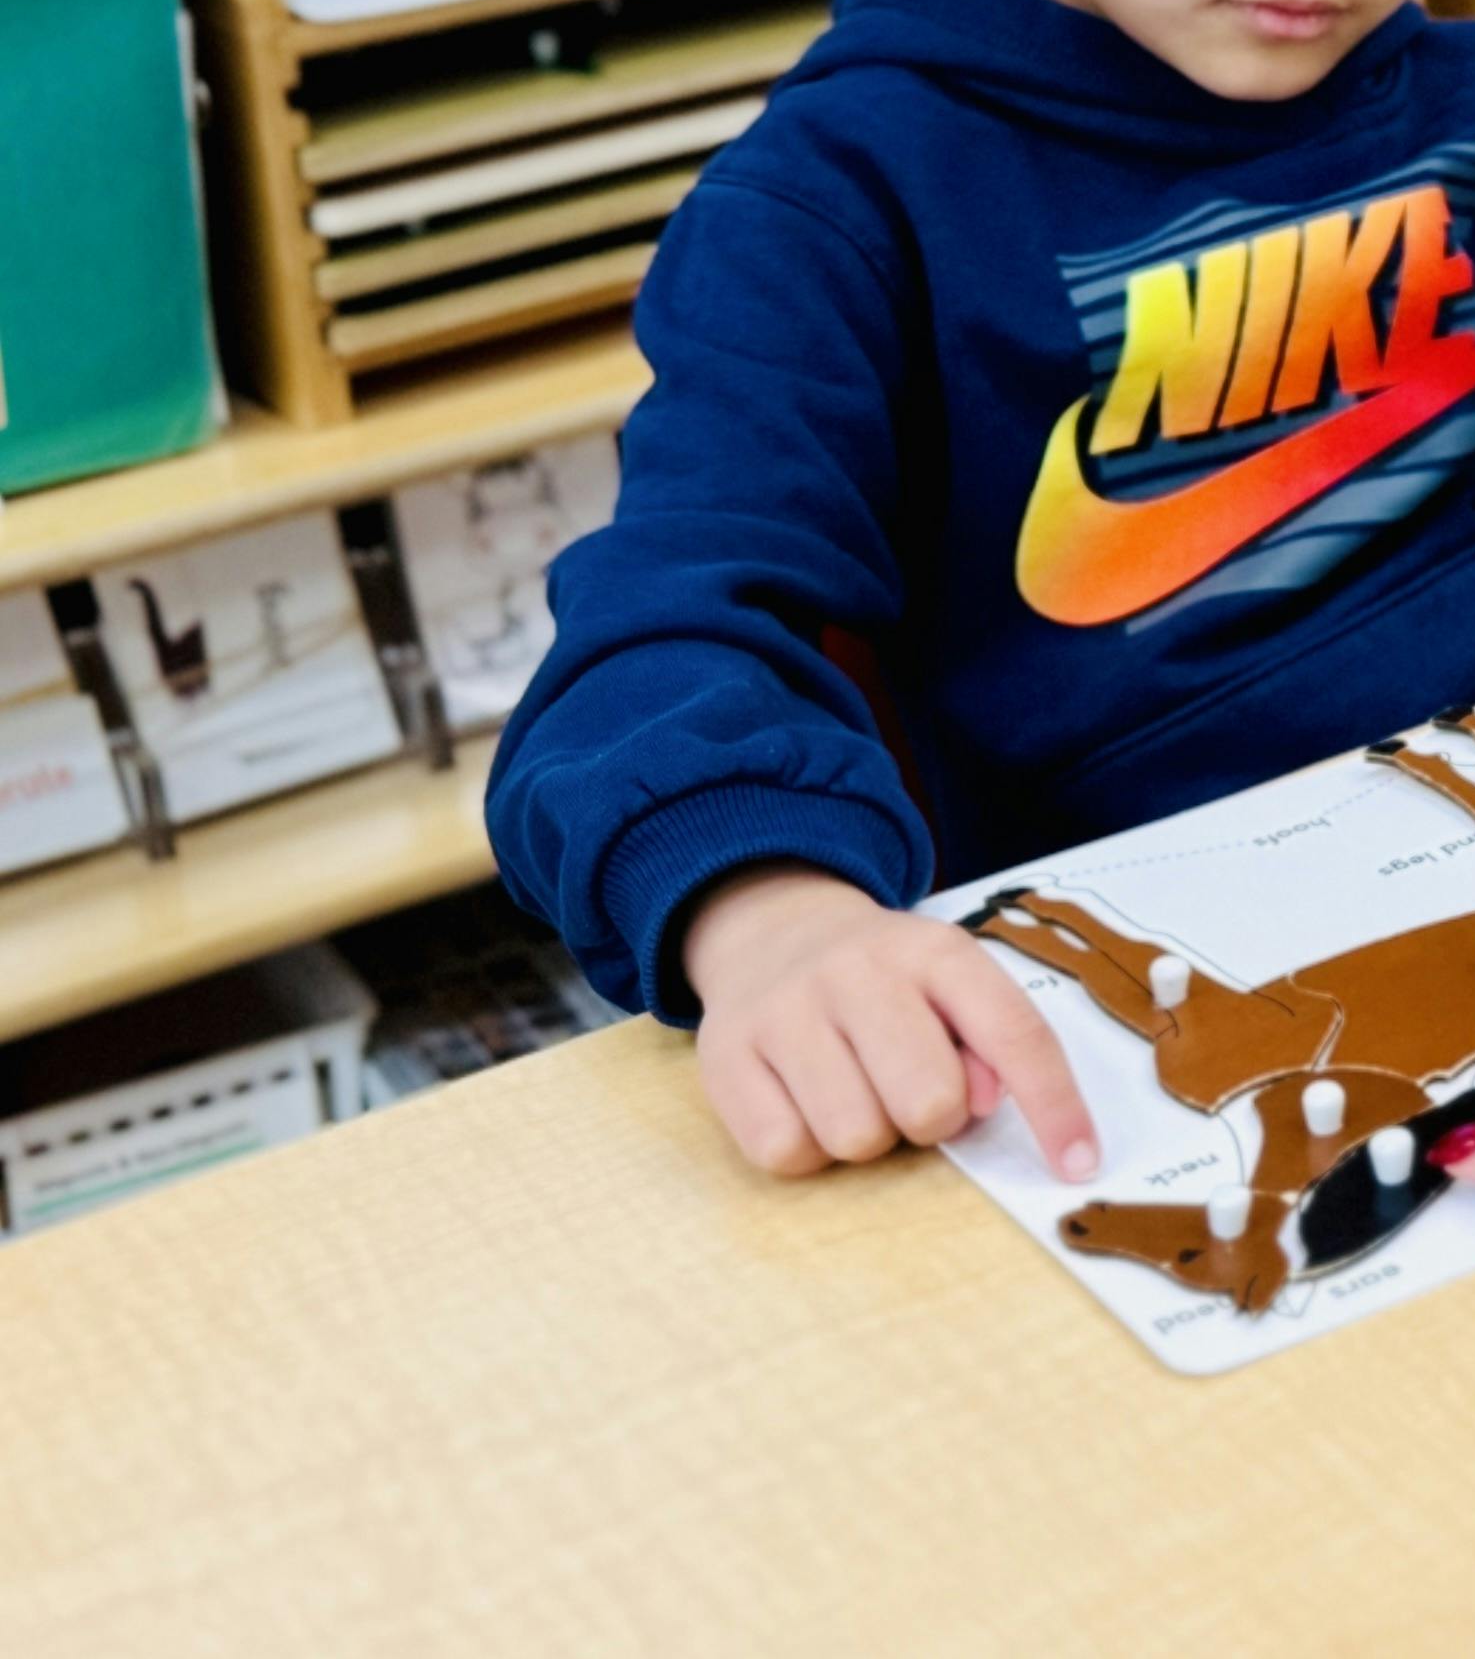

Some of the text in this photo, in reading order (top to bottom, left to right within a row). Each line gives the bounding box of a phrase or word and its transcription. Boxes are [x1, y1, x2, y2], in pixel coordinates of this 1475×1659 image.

[1252, 817, 1332, 847] hoofs
[1378, 852, 1438, 877] legs
[1143, 1151, 1219, 1187] neck
[1327, 1264, 1401, 1298] ears
